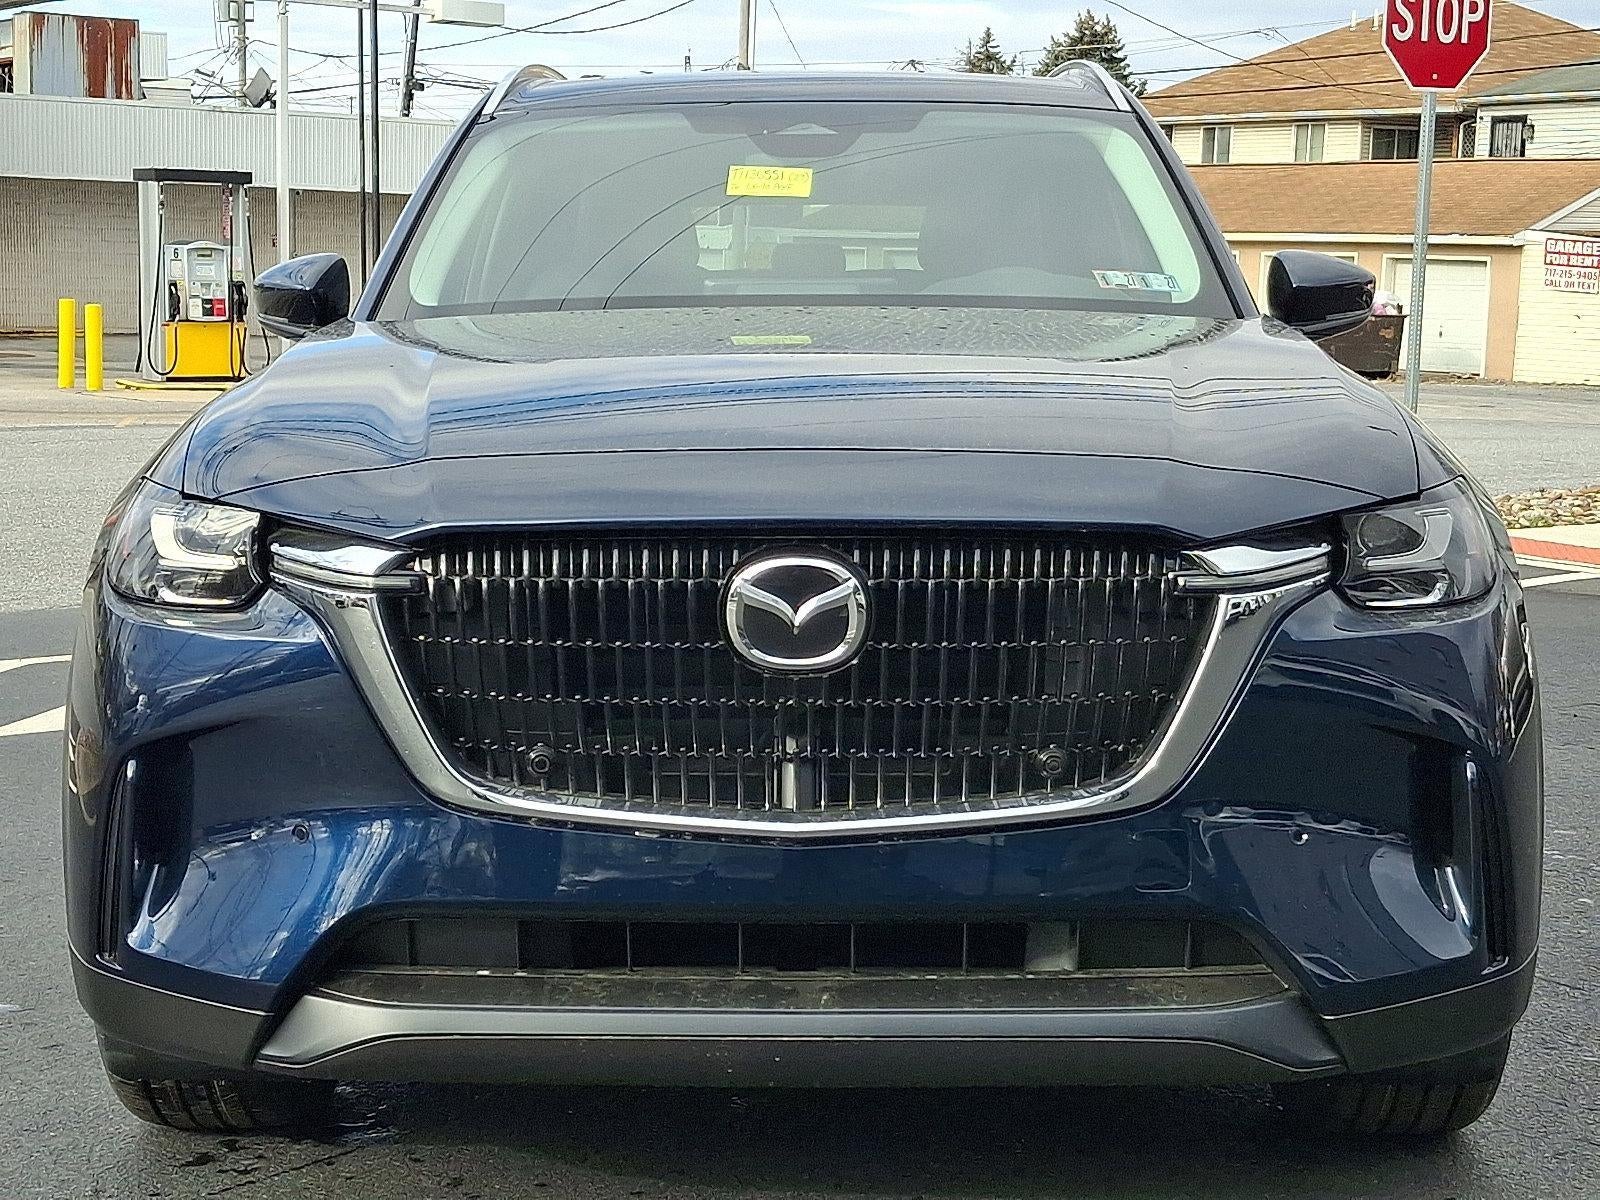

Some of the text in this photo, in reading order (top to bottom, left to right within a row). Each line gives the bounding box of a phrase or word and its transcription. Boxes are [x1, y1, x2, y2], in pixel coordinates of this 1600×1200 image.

[1391, 0, 1485, 43] STOP
[173, 247, 179, 259] 6
[1546, 240, 1600, 255] GARAGE
[1546, 254, 1598, 267] FOR RENT
[1545, 268, 1598, 281] 717-215-9405
[1544, 278, 1562, 288] CALL
[1577, 281, 1596, 290] TEXT
